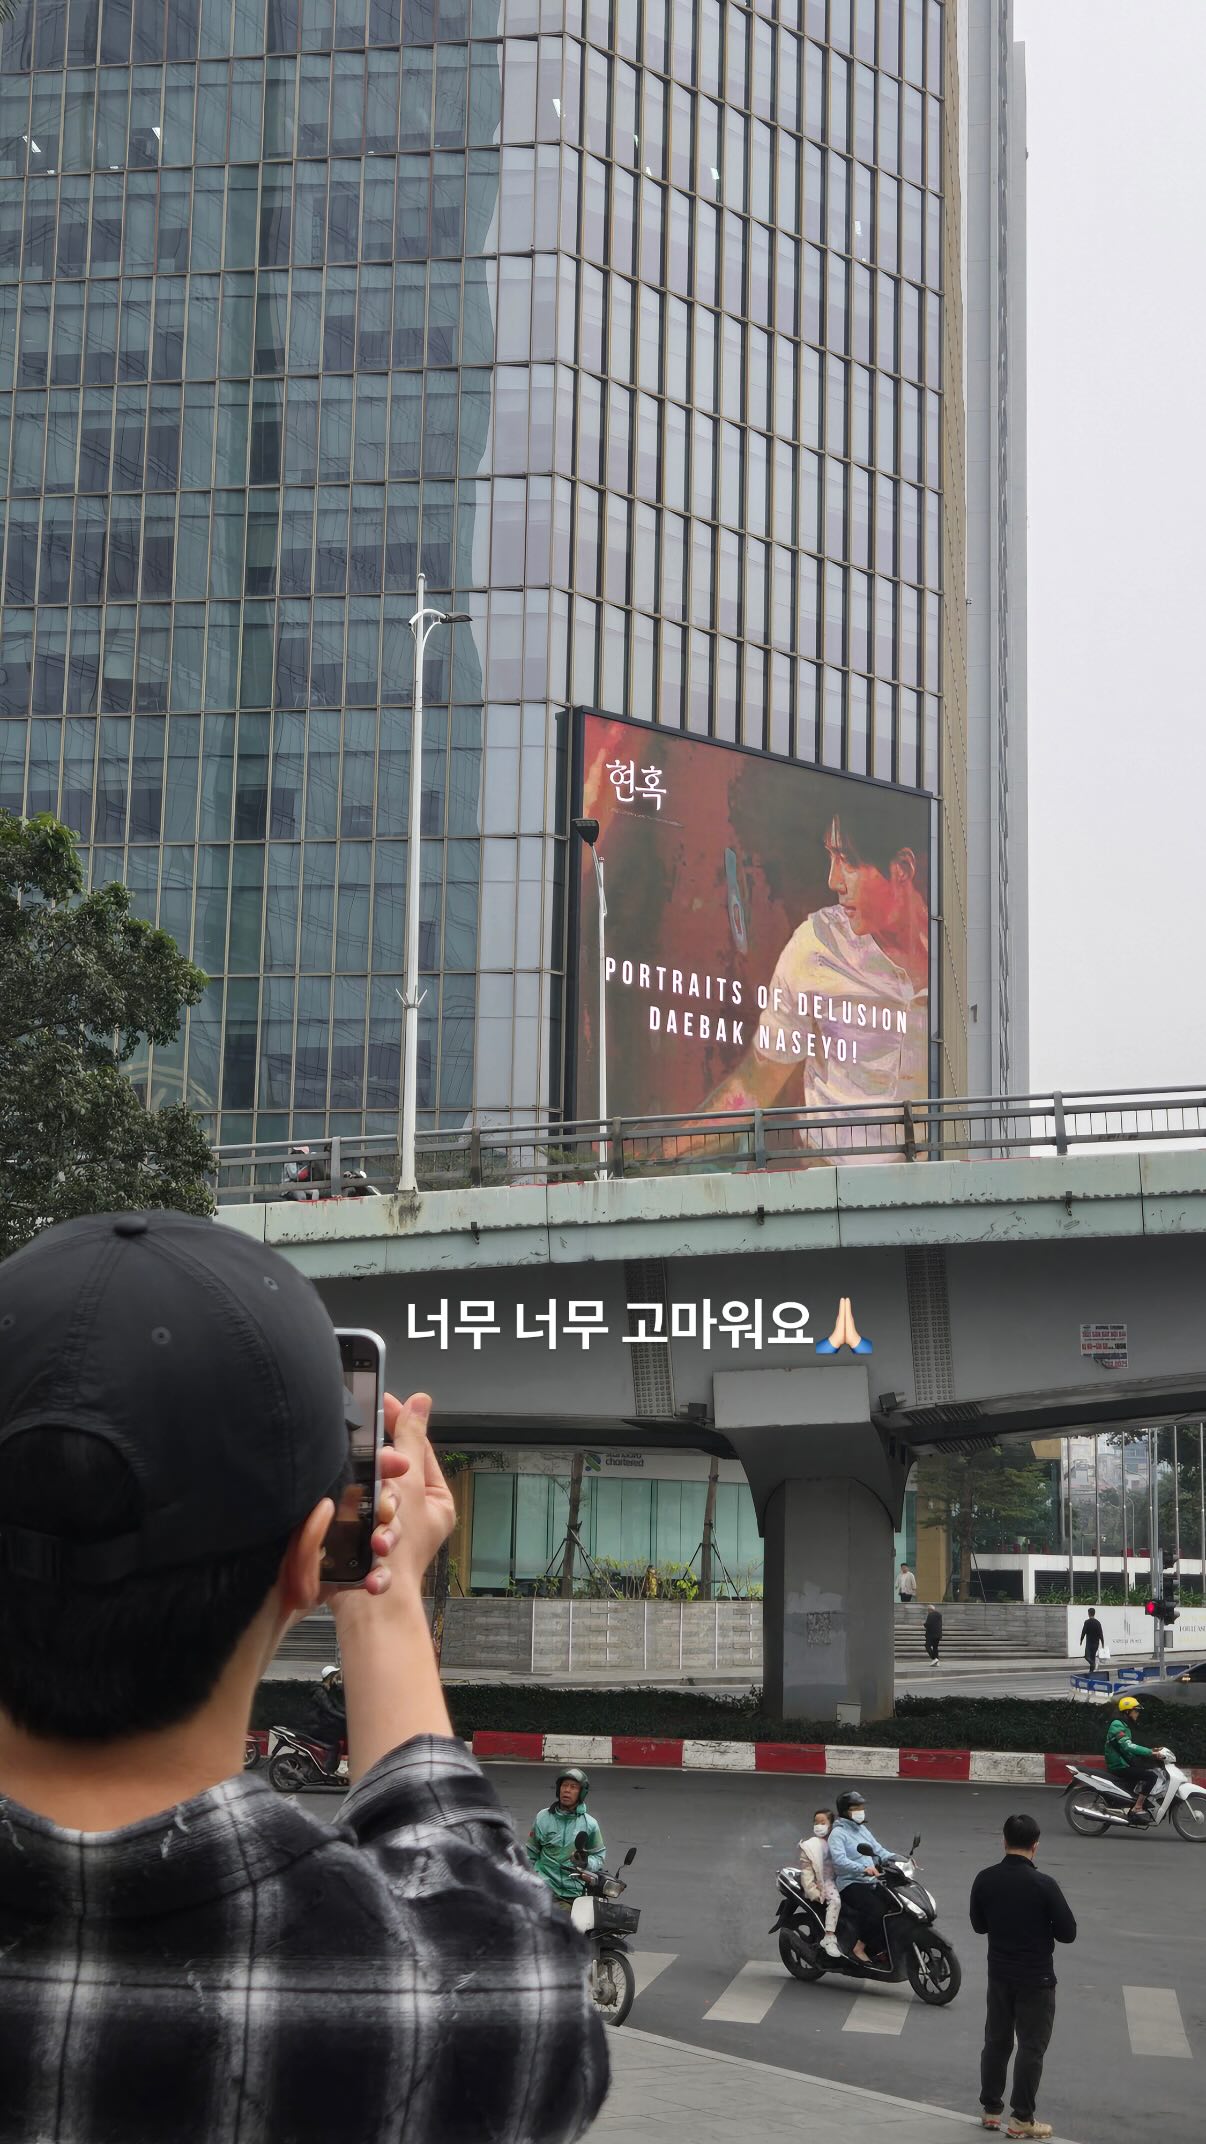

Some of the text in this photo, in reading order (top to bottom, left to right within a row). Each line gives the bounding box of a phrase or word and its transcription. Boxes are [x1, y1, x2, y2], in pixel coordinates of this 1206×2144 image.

[605, 759, 667, 811] 현혹
[605, 956, 907, 1034] PORTRAITS OF DELUSION
[649, 1006, 858, 1063] DAEBAK NASEYO!
